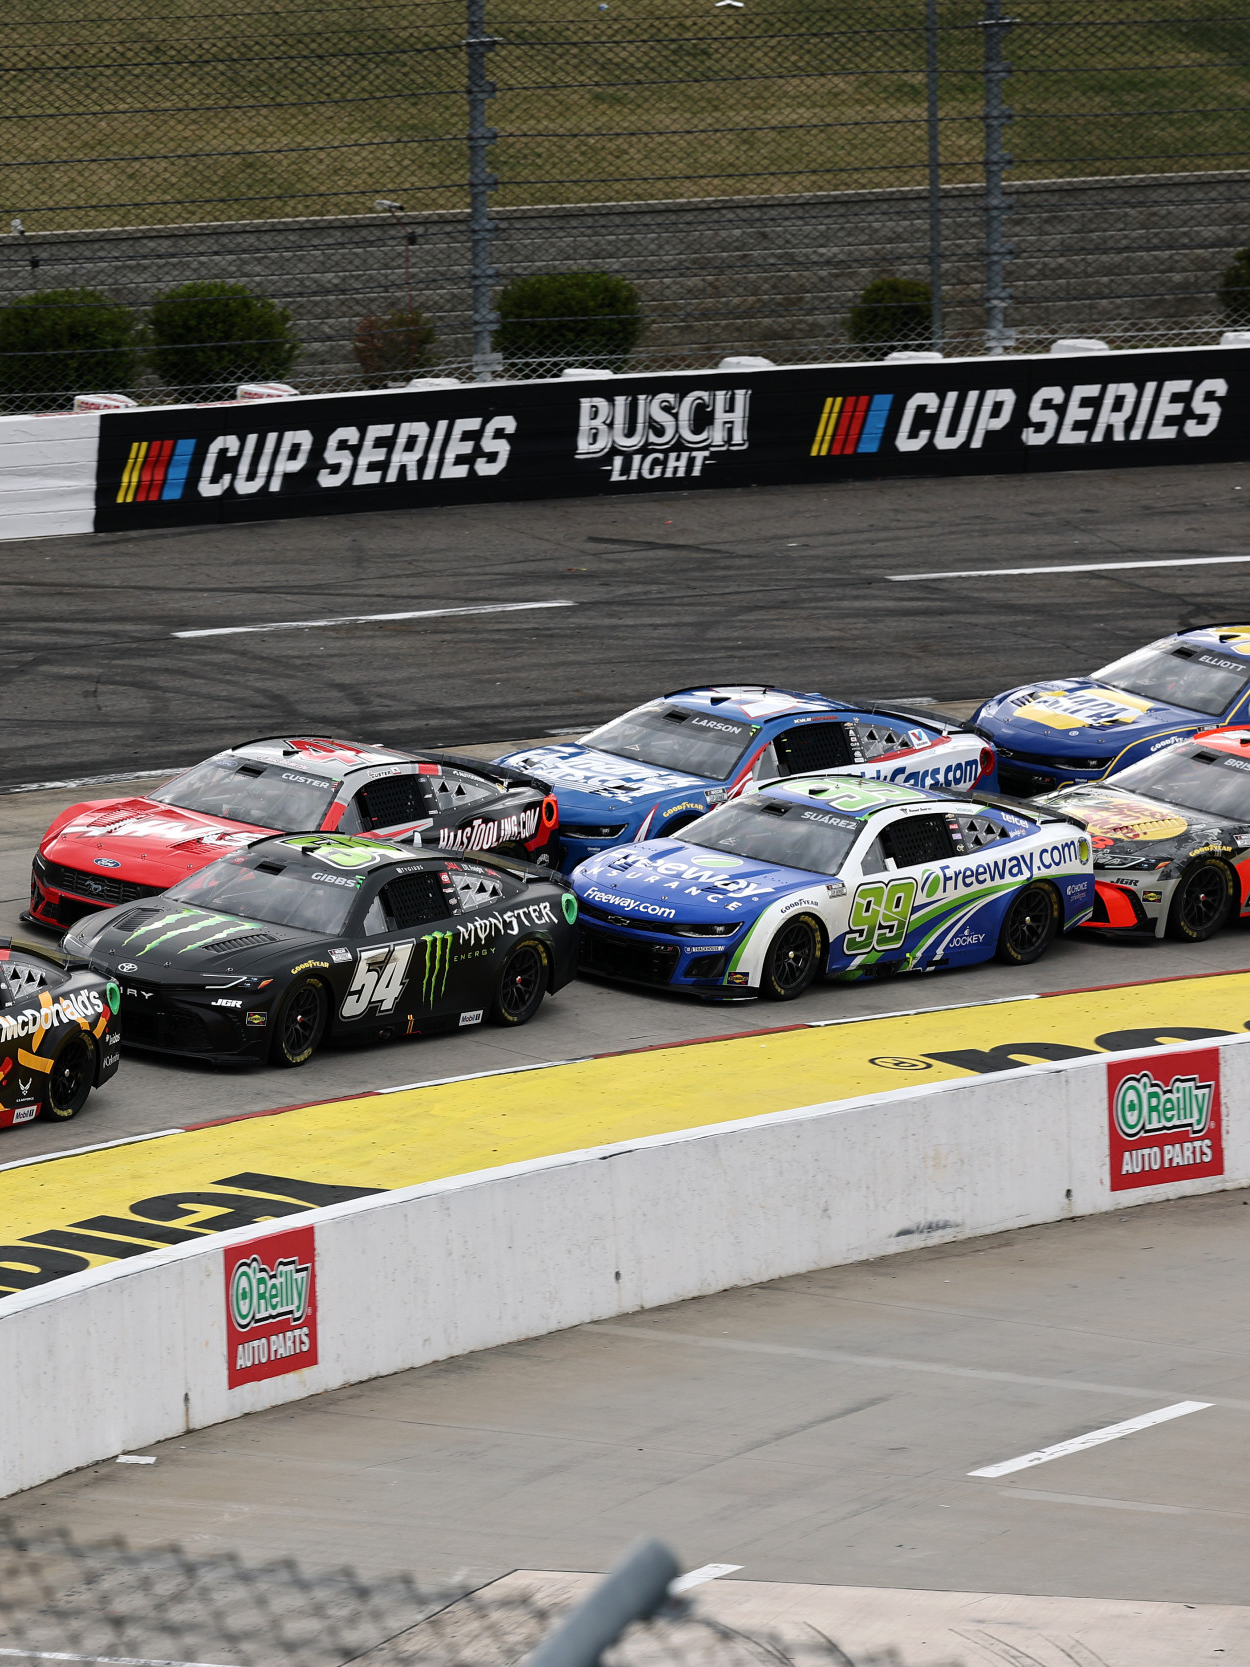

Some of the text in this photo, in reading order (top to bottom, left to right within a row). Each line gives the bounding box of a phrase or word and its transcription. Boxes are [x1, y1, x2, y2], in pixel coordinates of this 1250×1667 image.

[575, 389, 751, 459] BUSCH
[894, 378, 1229, 453] CUP SERIES
[197, 415, 518, 498] CUP SERIES
[608, 449, 711, 483] LIGHT
[1199, 655, 1246, 672] ELLIOTT
[691, 717, 742, 735] LARSON
[281, 772, 330, 790] CUSTER
[662, 801, 704, 818] GOODYEAR
[800, 811, 857, 830] SUÁREZ
[1000, 811, 1029, 829] telcel
[1188, 844, 1232, 858] GOODYEAR
[595, 849, 776, 898] Freeway
[940, 840, 1078, 893] Freeway.com
[311, 872, 357, 888] GIBBS
[1110, 877, 1140, 887] JGR
[583, 887, 676, 918] Freeway.com
[780, 899, 819, 914] GOODYEAR
[457, 902, 558, 946] MONSTER
[843, 877, 918, 957] 99
[949, 934, 986, 948] JOCKEY
[454, 947, 496, 962] ENERGY
[290, 959, 329, 975] GOODYEAR
[340, 938, 417, 1022] 54
[211, 998, 243, 1008] JGR
[15, 1108, 29, 1120] Mobil
[1118, 1076, 1209, 1135] O'Reilly
[1121, 1139, 1212, 1175] AUTO PARTS
[233, 1260, 307, 1325] O'Reilly
[236, 1326, 310, 1370] AUTO PARTS
